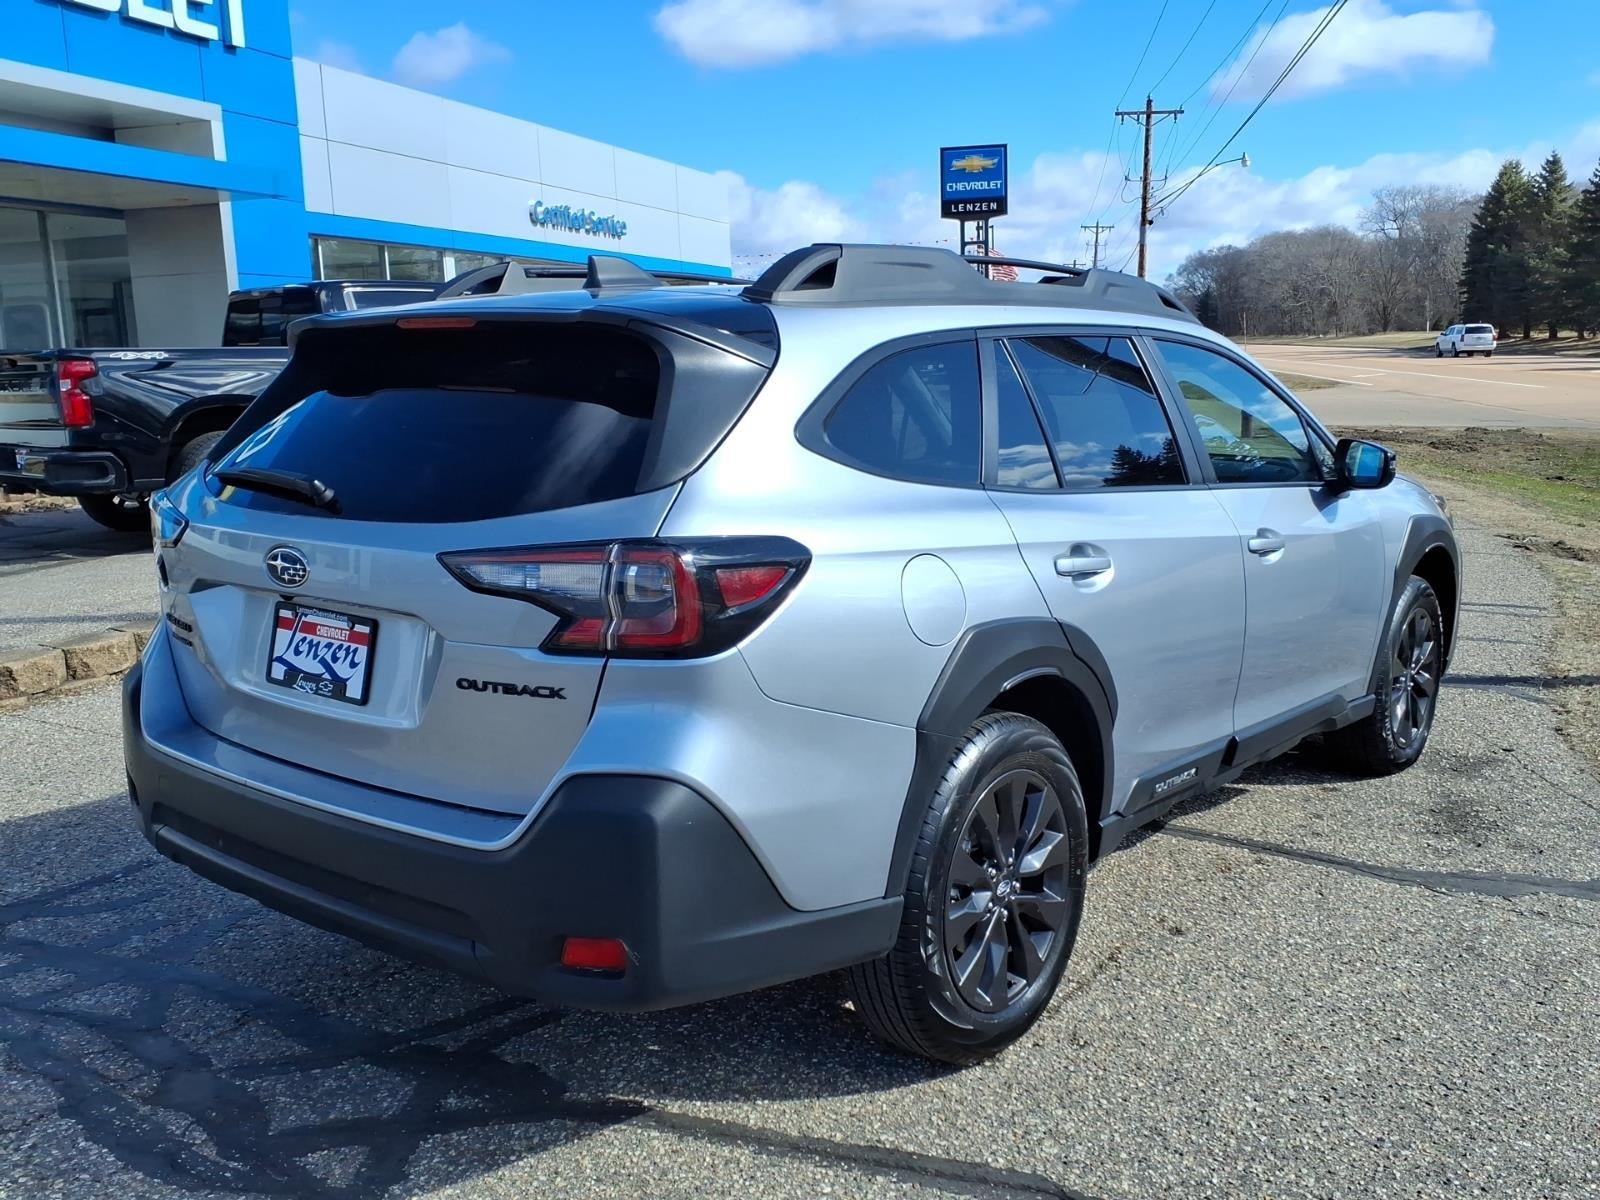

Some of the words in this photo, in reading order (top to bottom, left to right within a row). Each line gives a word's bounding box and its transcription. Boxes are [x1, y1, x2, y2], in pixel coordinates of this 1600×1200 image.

[946, 180, 1002, 192] CHEVROLET
[951, 202, 997, 213] LENZEN
[529, 200, 585, 233] Certified
[585, 210, 627, 240] Service
[316, 625, 350, 641] CHEVROLET
[271, 611, 362, 683] Lenzen
[456, 677, 567, 700] OUTBACK
[1155, 767, 1197, 792] OUTBACK
